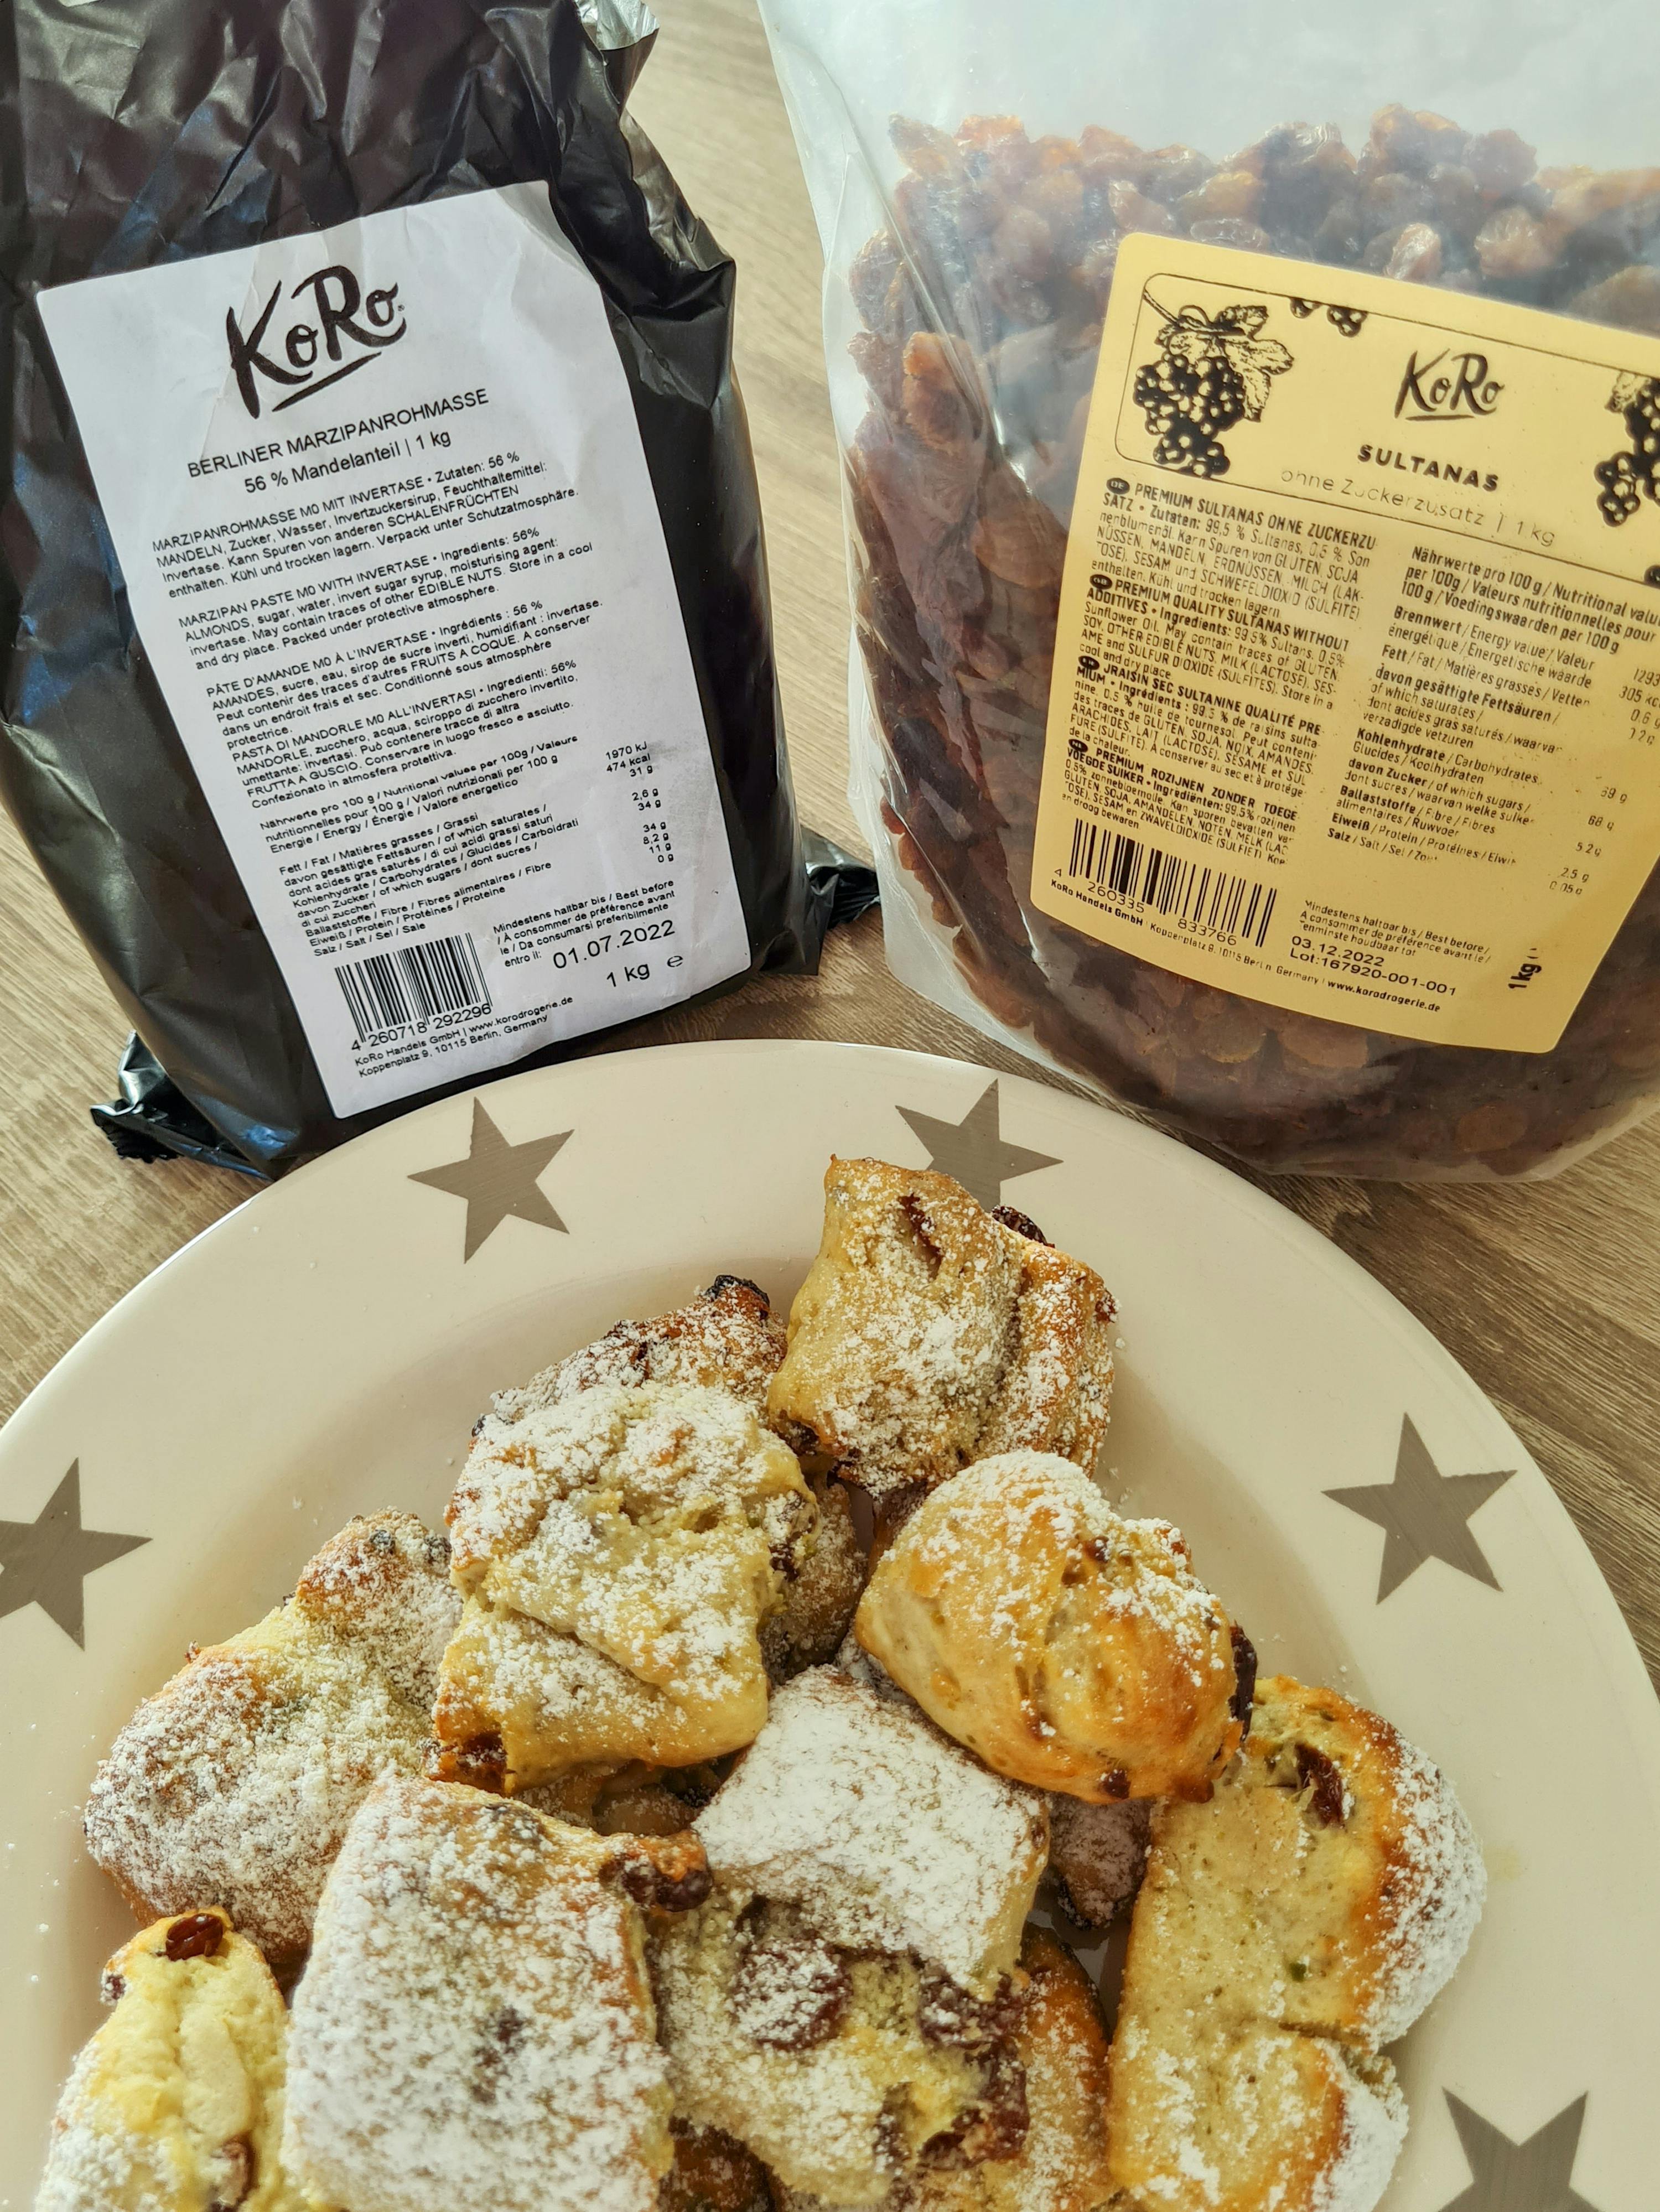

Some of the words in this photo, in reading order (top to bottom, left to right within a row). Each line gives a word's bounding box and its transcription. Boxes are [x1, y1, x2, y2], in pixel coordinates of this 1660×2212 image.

[226, 265, 407, 419] KoRo
[1394, 349, 1505, 419] KoRo
[188, 443, 283, 477] BERLINER
[286, 388, 489, 454] MARZIPANROHMASSE
[244, 475, 266, 493] 56
[270, 470, 288, 486] %
[291, 440, 401, 482] Mandelanteil
[416, 434, 424, 449] 1
[429, 431, 451, 448] kg
[1357, 444, 1498, 491] SULTANAS
[152, 508, 297, 551] MARZIPANROHMASSE
[322, 496, 345, 511] MIT
[349, 476, 424, 505] INVERTASE
[434, 463, 485, 483] Zutaten:
[488, 454, 504, 468] 56
[506, 451, 520, 463] %
[156, 543, 226, 567] MANDELN,
[228, 533, 276, 551] Zucker,
[277, 520, 331, 538] Wasser,
[334, 492, 440, 525] Invertzuckersirup,
[443, 461, 543, 497] Feuchthaltemittel:
[162, 562, 224, 581] Invertase.
[227, 553, 259, 567] Kann
[262, 541, 306, 559] Spuren
[308, 535, 331, 546] von
[335, 522, 384, 541] anderen
[387, 484, 518, 527] SCHALENFRÜCHTEN
[1267, 514, 1303, 534] OHNE
[169, 578, 224, 598] enthalten.
[230, 567, 257, 583] Kühl
[260, 561, 283, 575] und
[284, 551, 330, 569] trocken
[332, 541, 374, 557] lagern.
[376, 524, 430, 546] Verpackt
[433, 517, 463, 531] unter
[467, 489, 578, 522] Schutzatmosphäre.
[178, 602, 247, 627] MARZIPAN
[250, 590, 294, 610] PASTE
[318, 575, 354, 592] WITH
[356, 555, 429, 582] INVERTASE
[440, 537, 509, 561] Ingredients:
[512, 527, 539, 542] 56%
[186, 617, 253, 642] ALMONDS,
[257, 609, 294, 624] sugar,
[296, 598, 335, 613] water,
[336, 586, 371, 603] invert
[374, 578, 407, 593] sugar
[411, 569, 447, 584] syrup,
[450, 549, 520, 574] moisturising
[522, 538, 554, 555] agent:
[190, 636, 246, 655] invertase.
[252, 627, 278, 640] May
[282, 614, 326, 632] contain
[328, 604, 366, 620] traces
[370, 596, 381, 609] of
[385, 590, 414, 604] other
[417, 575, 465, 596] EDIBLE
[509, 558, 540, 572] Store
[543, 554, 554, 563] in
[568, 542, 592, 556] cool
[1404, 567, 1428, 580] per
[1430, 568, 1460, 592] 100g
[1472, 579, 1520, 606] Valeurs
[1522, 598, 1622, 634] nutritionnelles
[1623, 626, 1654, 641] pour
[1412, 546, 1481, 575] Nährwerte
[1482, 567, 1506, 583] pro
[1508, 570, 1532, 590] 100
[1532, 581, 1542, 595] g
[1552, 582, 1627, 617] Nutritional
[195, 656, 218, 669] and
[221, 652, 238, 663] dry
[242, 643, 278, 660] place.
[282, 627, 326, 647] Packed
[329, 619, 362, 635] under
[366, 604, 424, 627] protective
[427, 585, 495, 609] atmosphere.
[1111, 579, 1170, 604] PREMIUM
[1173, 594, 1225, 619] QUALITY
[1226, 609, 1290, 636] SULTANAS
[1293, 626, 1348, 651] WITHOUT
[1394, 605, 1462, 634] Brennwert
[1401, 580, 1424, 598] 100
[1423, 589, 1433, 604] g
[1444, 590, 1558, 635] Voedingswaarden
[1559, 628, 1583, 641] per
[1586, 631, 1610, 649] 100
[1609, 641, 1619, 655] g
[212, 687, 278, 710] AMANDES,
[282, 678, 318, 692] sucre,
[321, 671, 347, 681] eau,
[350, 661, 378, 674] sirop
[382, 655, 396, 665] de
[400, 646, 432, 660] sucre
[434, 634, 474, 651] inverti,
[476, 616, 537, 640] humidifiant
[546, 600, 602, 620] invertase.
[1375, 666, 1412, 686] davon
[1413, 678, 1479, 704] gesättigte
[1481, 693, 1551, 721] Fettsäuren
[605, 745, 632, 760] 1970
[635, 741, 647, 752] kJ
[1356, 727, 1445, 761] Kohlenhydrate
[1331, 812, 1370, 830] Eiweiß
[1340, 785, 1418, 816] Ballaststoffe
[493, 911, 551, 933] Mindestens
[553, 901, 588, 916] haltbar
[590, 896, 606, 905] bis
[615, 889, 639, 900] Best
[641, 880, 673, 894] before
[1051, 879, 1073, 895] KoRo
[1076, 890, 1112, 913] Handels
[1114, 907, 1143, 926] GmbH
[1054, 869, 1062, 877] 4
[1088, 881, 1144, 913] 260335
[1177, 918, 1237, 945] 833766
[504, 954, 530, 967] entro
[553, 919, 675, 968] 01.07.2022
[606, 972, 616, 987] 1
[624, 963, 650, 982] kg
[1290, 947, 1455, 995] Lot:167920-001-001
[1291, 935, 1384, 967] 03.12.2022
[351, 1040, 361, 1051] 4
[369, 1022, 428, 1047] 260718
[433, 1003, 491, 1029] 292296
[1327, 981, 1440, 1012] www.korodrogerie.de
[355, 1052, 383, 1066] KoRo
[386, 1040, 427, 1056] Handels
[429, 1029, 460, 1043] GmbH
[468, 996, 573, 1032] www.korodrogerie.de
[359, 1053, 420, 1077] Koppenplatz
[434, 1038, 466, 1053] 10115
[469, 1031, 501, 1043] Berlin,
[504, 1014, 547, 1034] Germany
